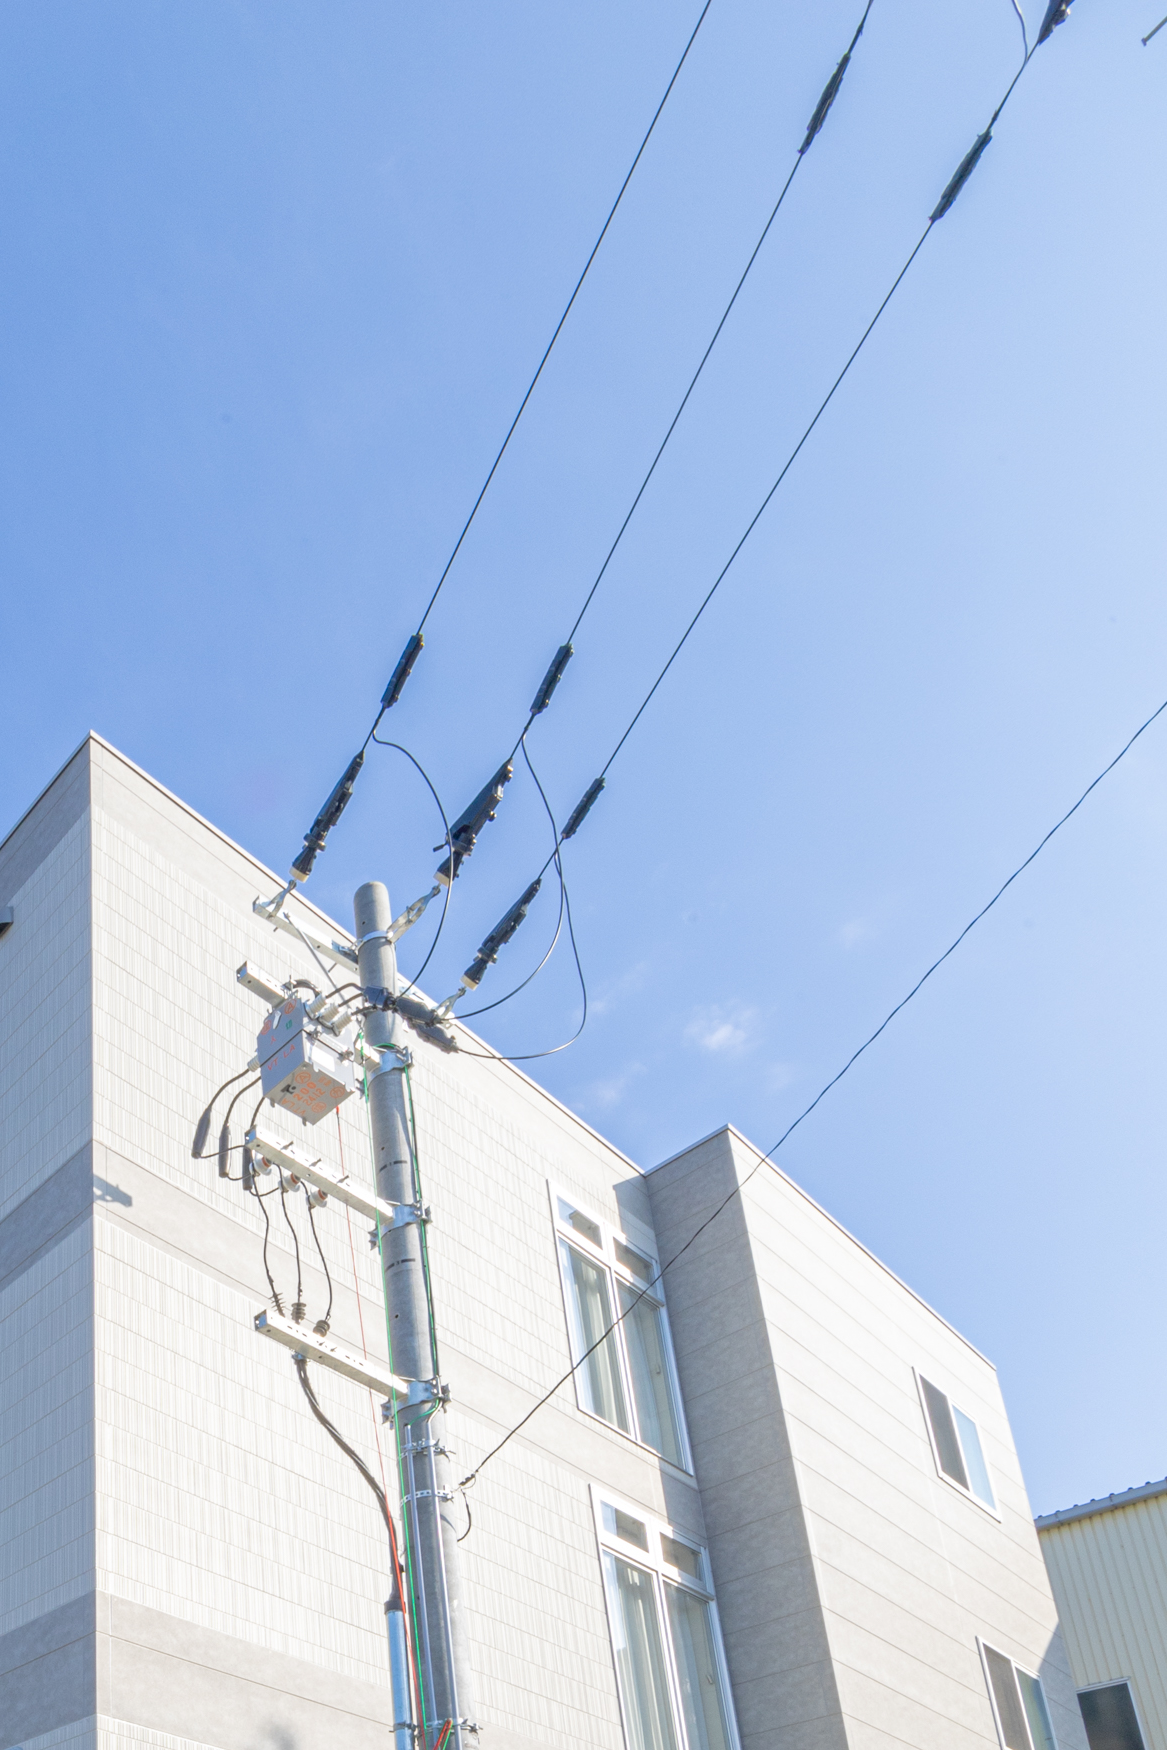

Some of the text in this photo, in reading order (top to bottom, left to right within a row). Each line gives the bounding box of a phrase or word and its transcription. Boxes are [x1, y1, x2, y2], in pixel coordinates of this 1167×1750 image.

[267, 1043, 296, 1071] VT LA
[293, 1081, 317, 1101] 200
